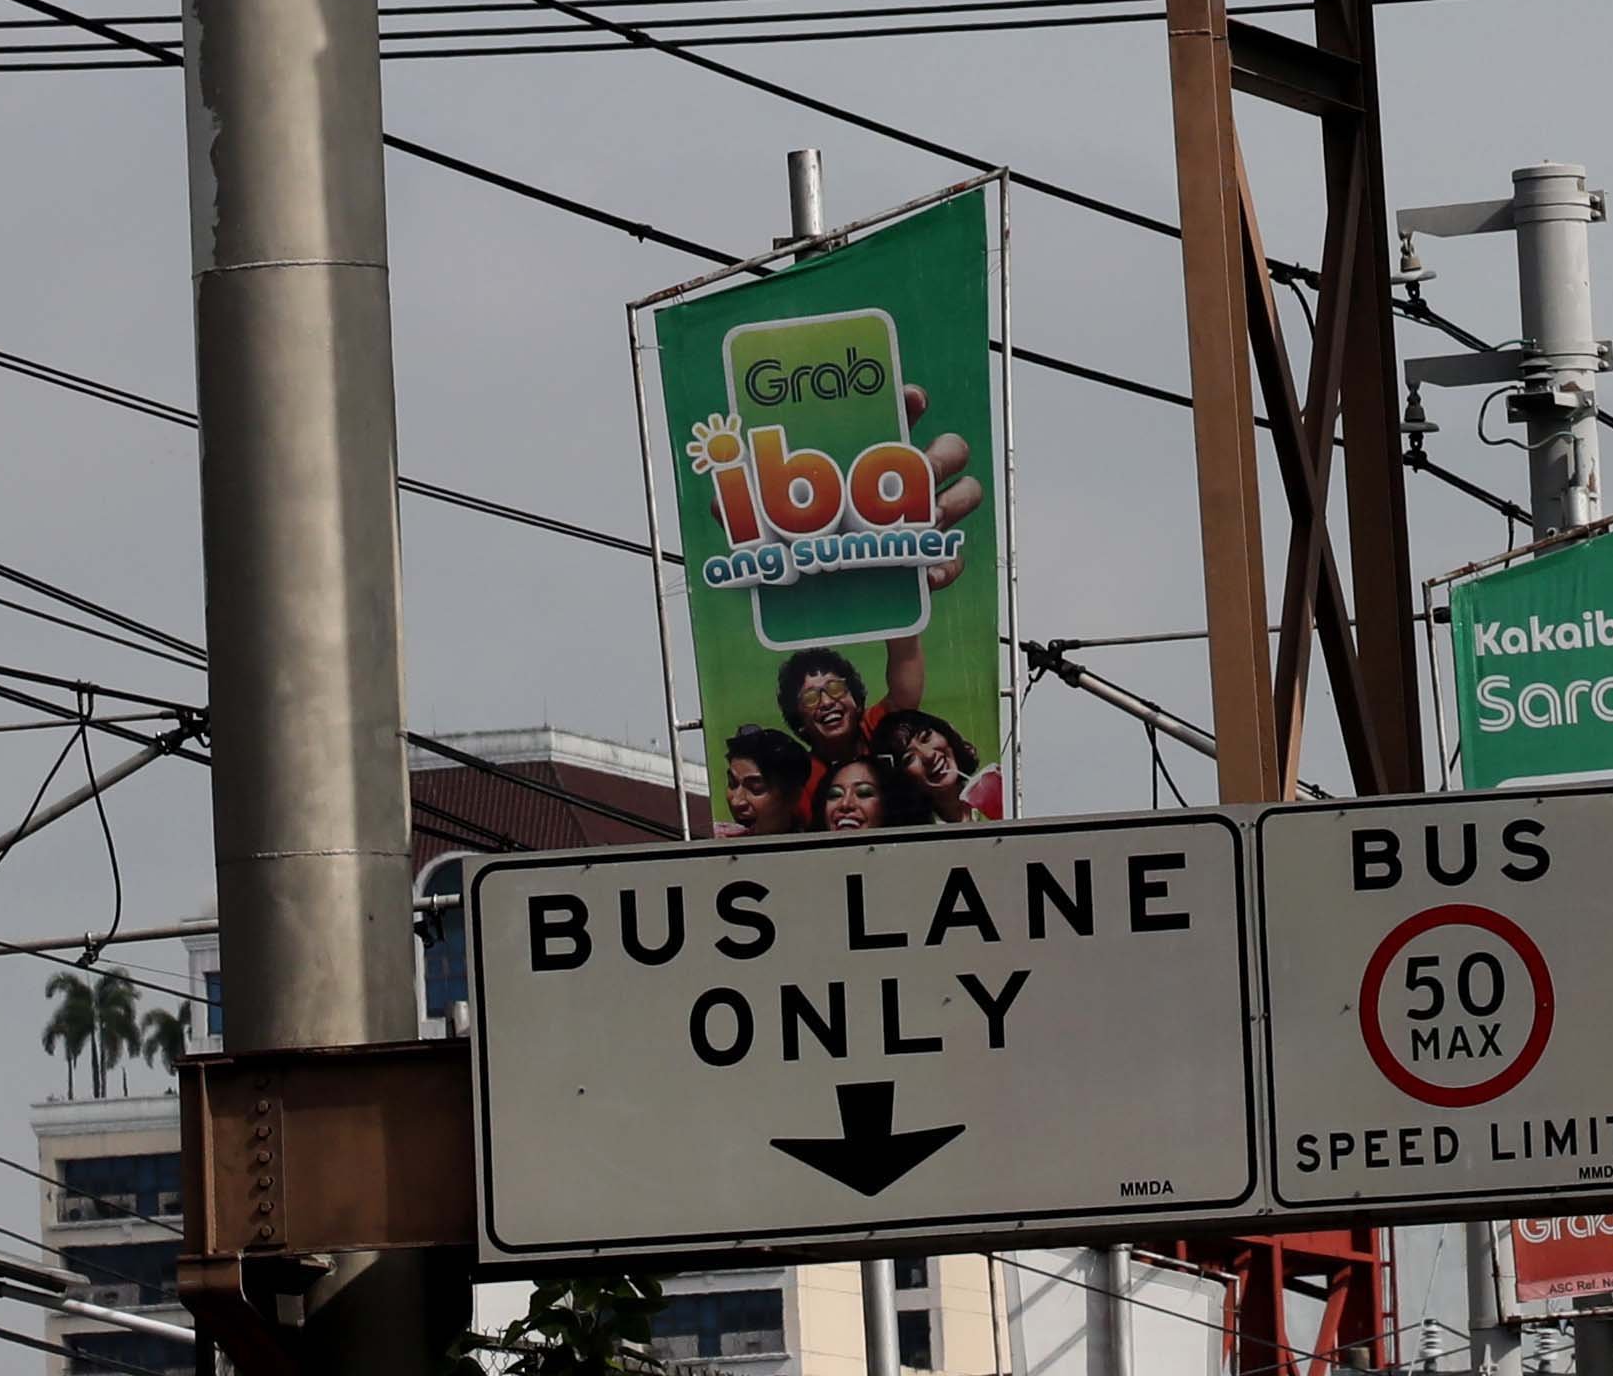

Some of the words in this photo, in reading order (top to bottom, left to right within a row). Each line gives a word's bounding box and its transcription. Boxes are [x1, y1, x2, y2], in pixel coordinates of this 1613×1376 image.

[745, 347, 885, 406] Grab
[704, 420, 937, 546] iba
[703, 542, 784, 584] ang
[794, 530, 963, 569] summer
[1352, 819, 1551, 891] BUS
[528, 880, 776, 972] BUS
[846, 852, 1191, 950] LANE
[1404, 951, 1505, 1021] 50
[689, 969, 1031, 1067] ONLY
[1412, 1024, 1503, 1061] MAX
[1297, 1126, 1459, 1173] SPEED
[1120, 1180, 1175, 1197] MMDA
[1549, 1280, 1574, 1295] ASC
[1577, 1280, 1599, 1292] Ref.
